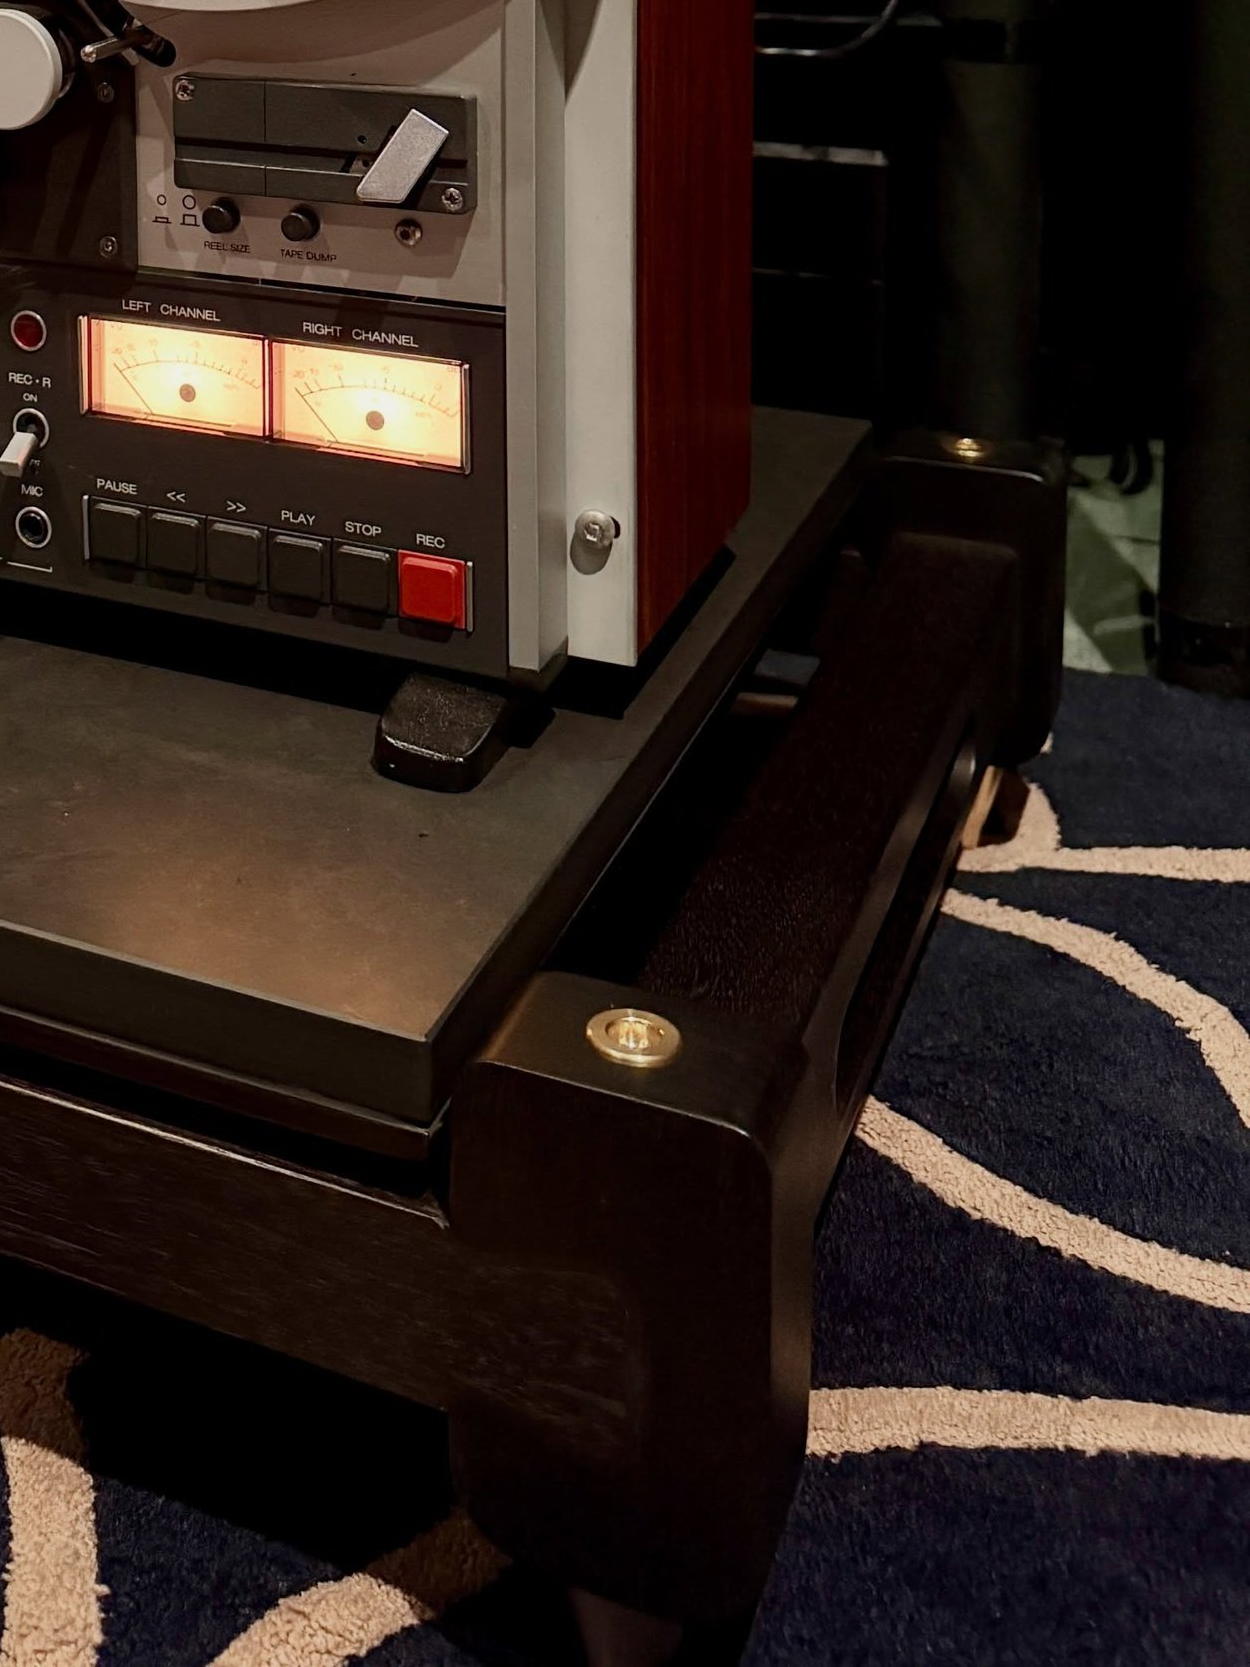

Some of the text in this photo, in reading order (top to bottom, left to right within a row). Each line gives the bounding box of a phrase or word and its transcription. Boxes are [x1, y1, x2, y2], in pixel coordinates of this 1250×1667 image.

[204, 241, 251, 253] REEL SIZE
[281, 248, 336, 262] TAPE DUMP
[122, 299, 221, 321] LEFT CHANNEL
[302, 322, 419, 348] RIGHT CHANNEL
[8, 372, 51, 388] REC R
[22, 393, 38, 403] ON
[21, 484, 44, 497] MIC
[96, 478, 137, 495] PAUSE
[281, 510, 316, 526] PLAY
[345, 521, 382, 537] STOP
[416, 533, 446, 549] REC
